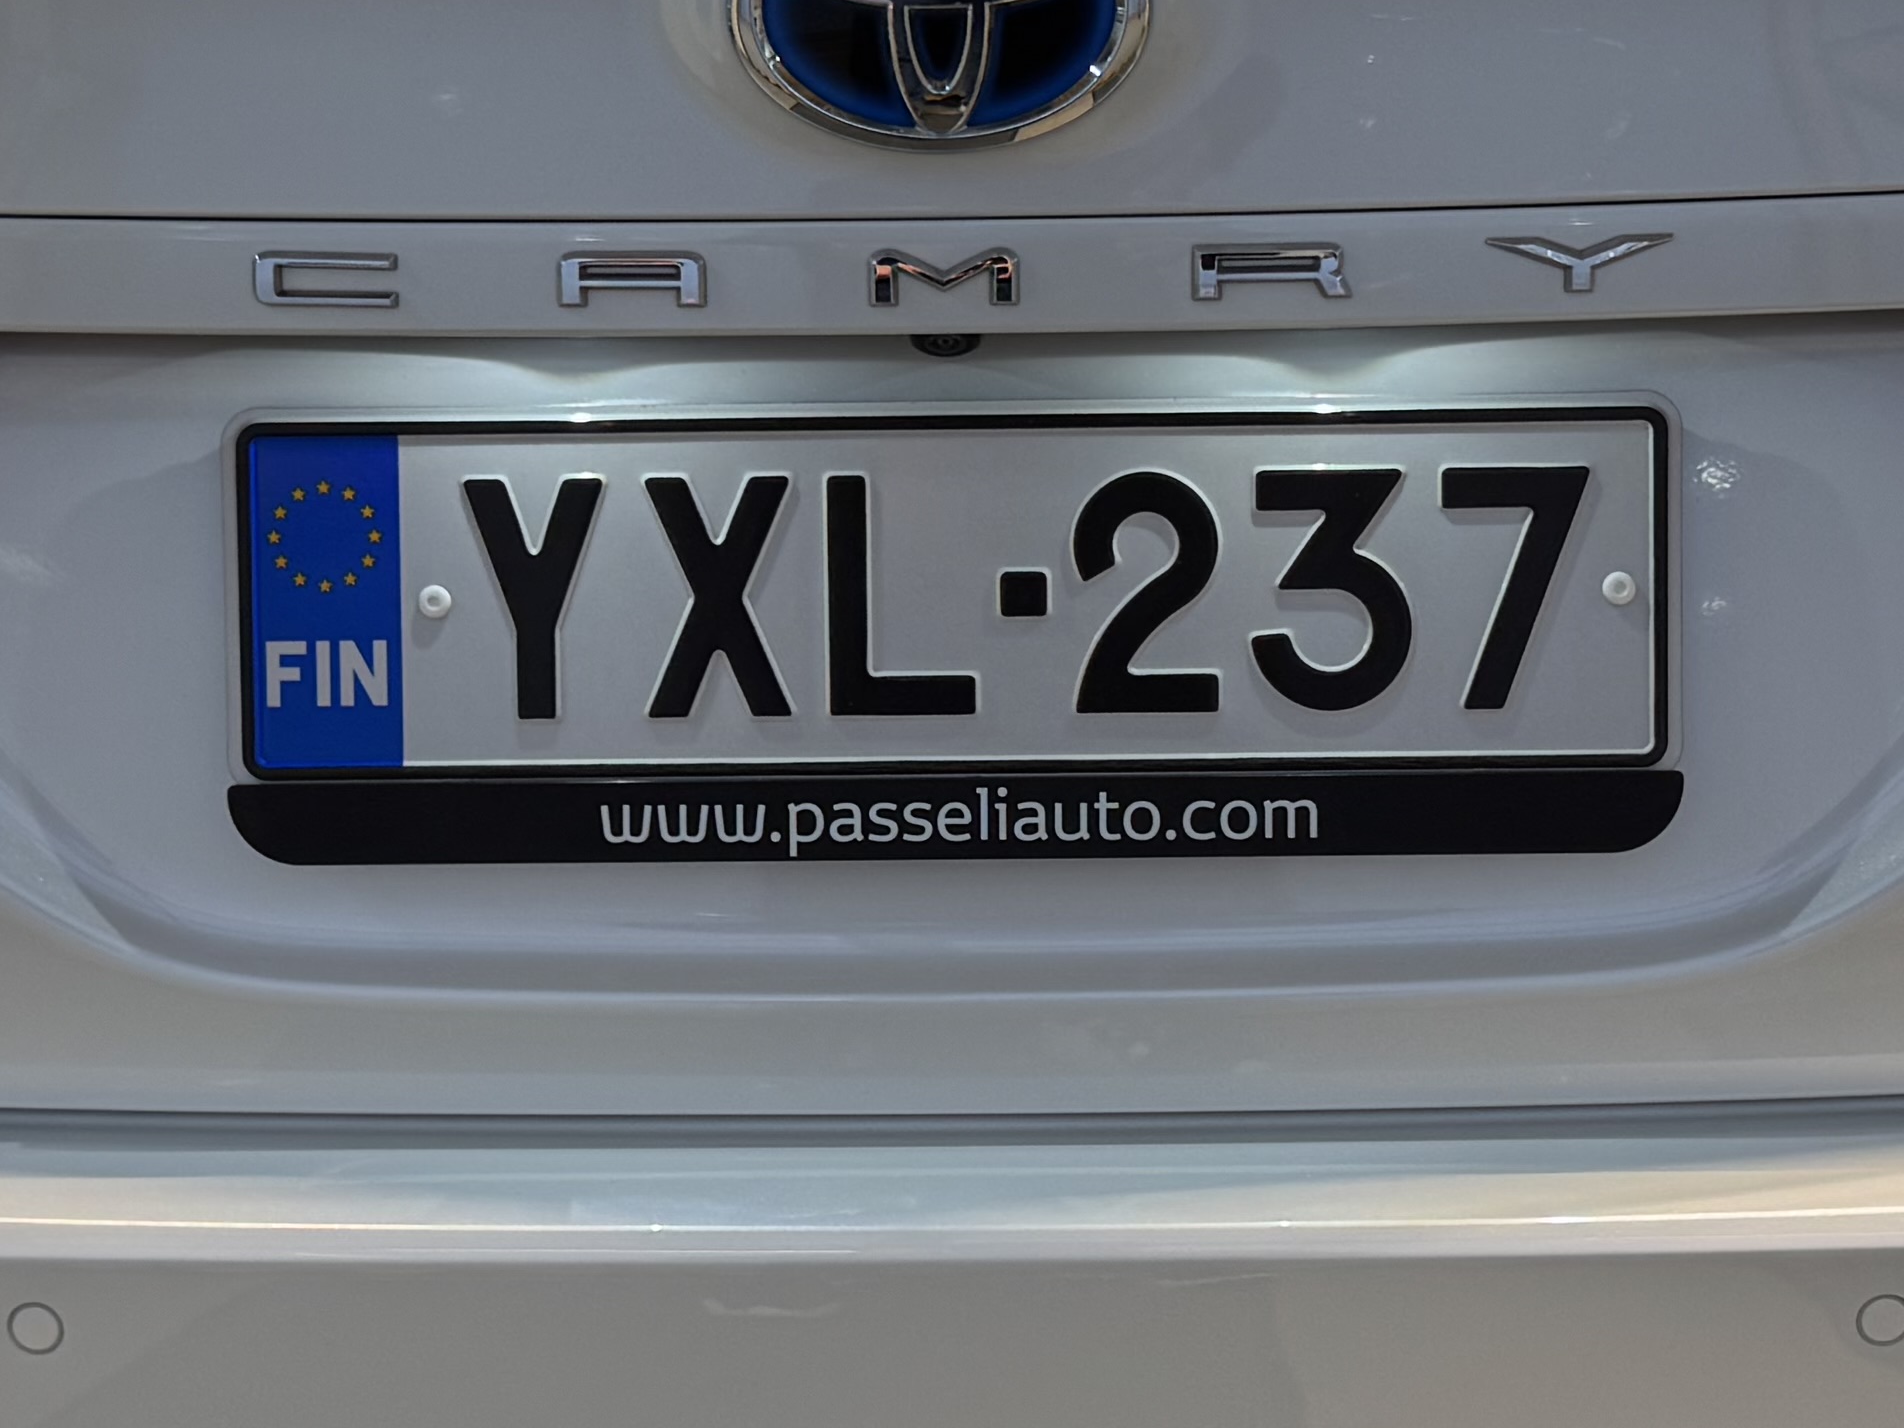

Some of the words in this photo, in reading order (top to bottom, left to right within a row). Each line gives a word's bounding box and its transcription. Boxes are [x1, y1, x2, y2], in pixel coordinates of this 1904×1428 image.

[250, 230, 1675, 310] CAMRY
[264, 637, 391, 710] FIN
[598, 784, 1322, 858] www.passeliauto.com
